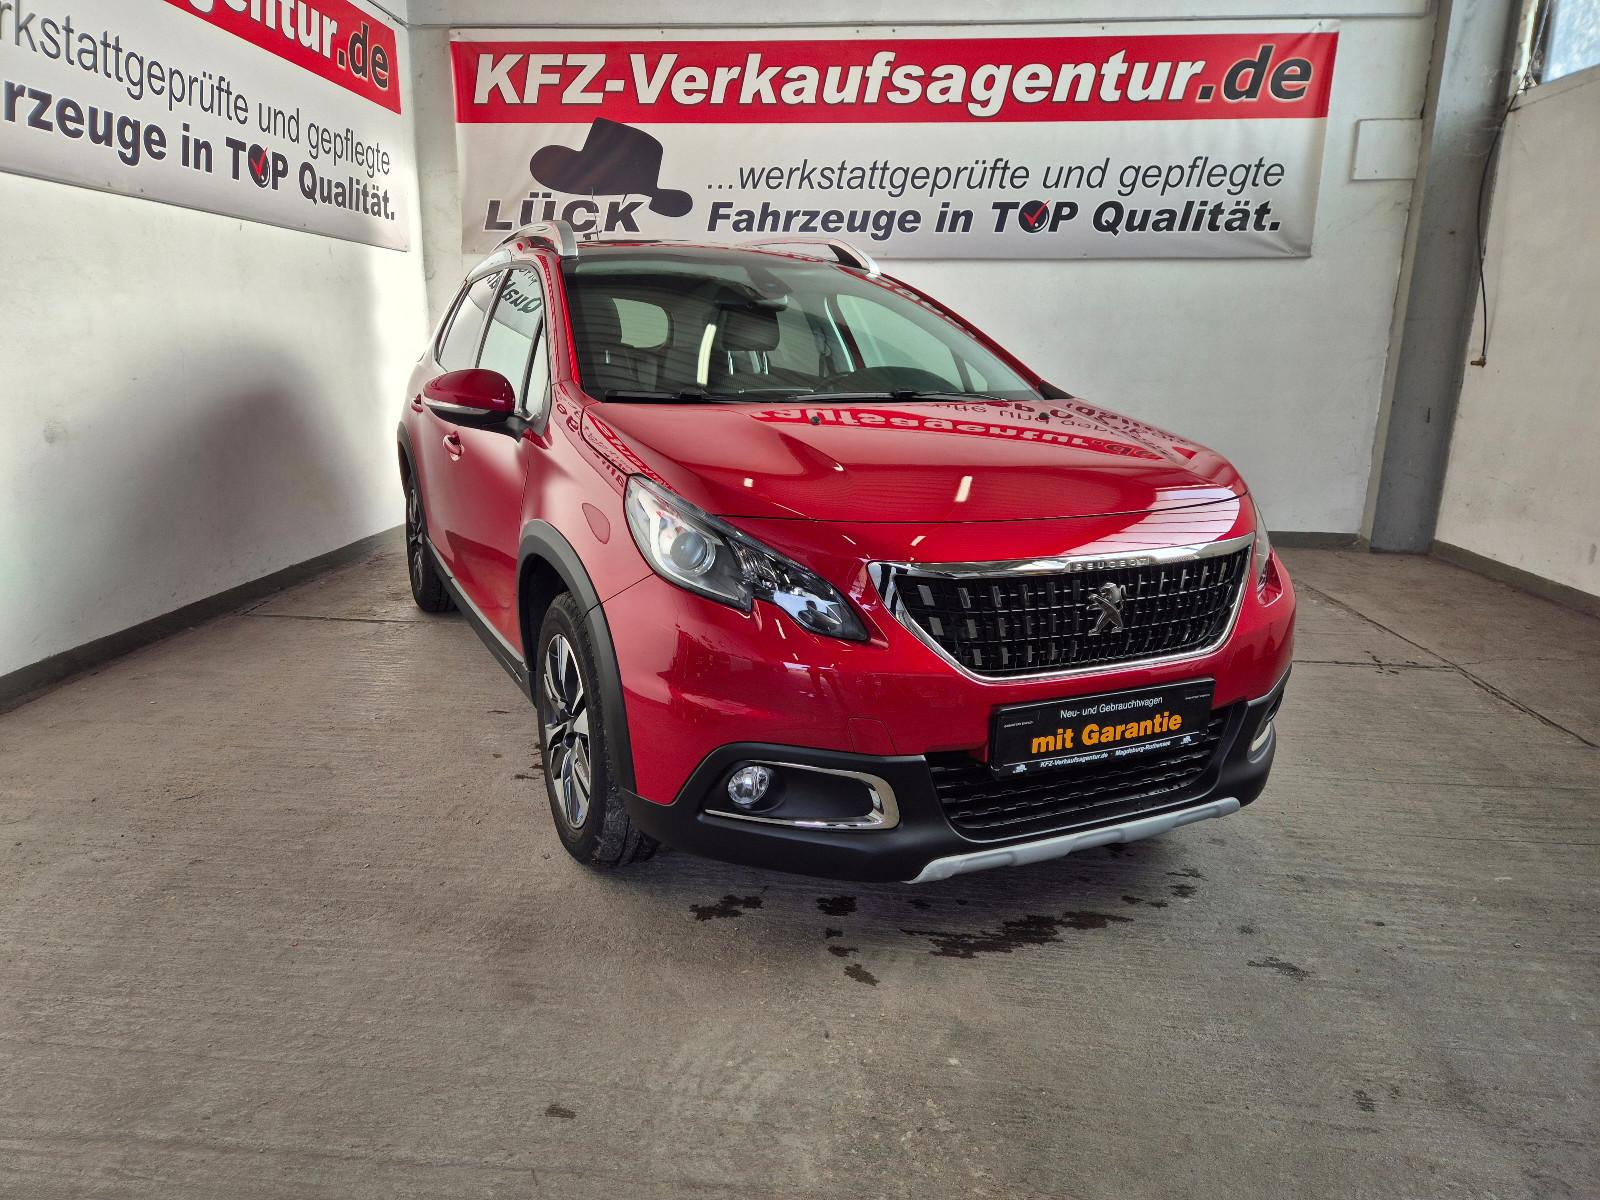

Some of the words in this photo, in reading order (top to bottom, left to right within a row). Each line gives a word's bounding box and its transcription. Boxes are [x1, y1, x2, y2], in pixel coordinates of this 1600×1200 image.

[473, 44, 1313, 118] KFZ-Verkaufsagentur.de
[4, 80, 167, 167] rzeuge
[182, 122, 213, 174] in
[226, 136, 288, 191] TOP
[299, 161, 395, 221] Qualität.
[258, 102, 300, 144] und
[308, 128, 391, 176] gepflegte
[1042, 157, 1109, 189] und
[1118, 156, 1285, 196] gepflegte
[485, 192, 645, 233] LÜCK
[707, 200, 921, 240] Fahrzeuge
[935, 202, 974, 233] in
[992, 200, 1078, 234] TOP
[1093, 200, 1281, 236] Qualität.
[1075, 557, 1148, 571] PEUGEOT
[1060, 708, 1081, 719] Neu-
[1082, 705, 1098, 716] und
[1099, 695, 1163, 713] Gebrauchtwagen
[1031, 727, 1075, 754] mit
[1081, 711, 1182, 746] Garantie
